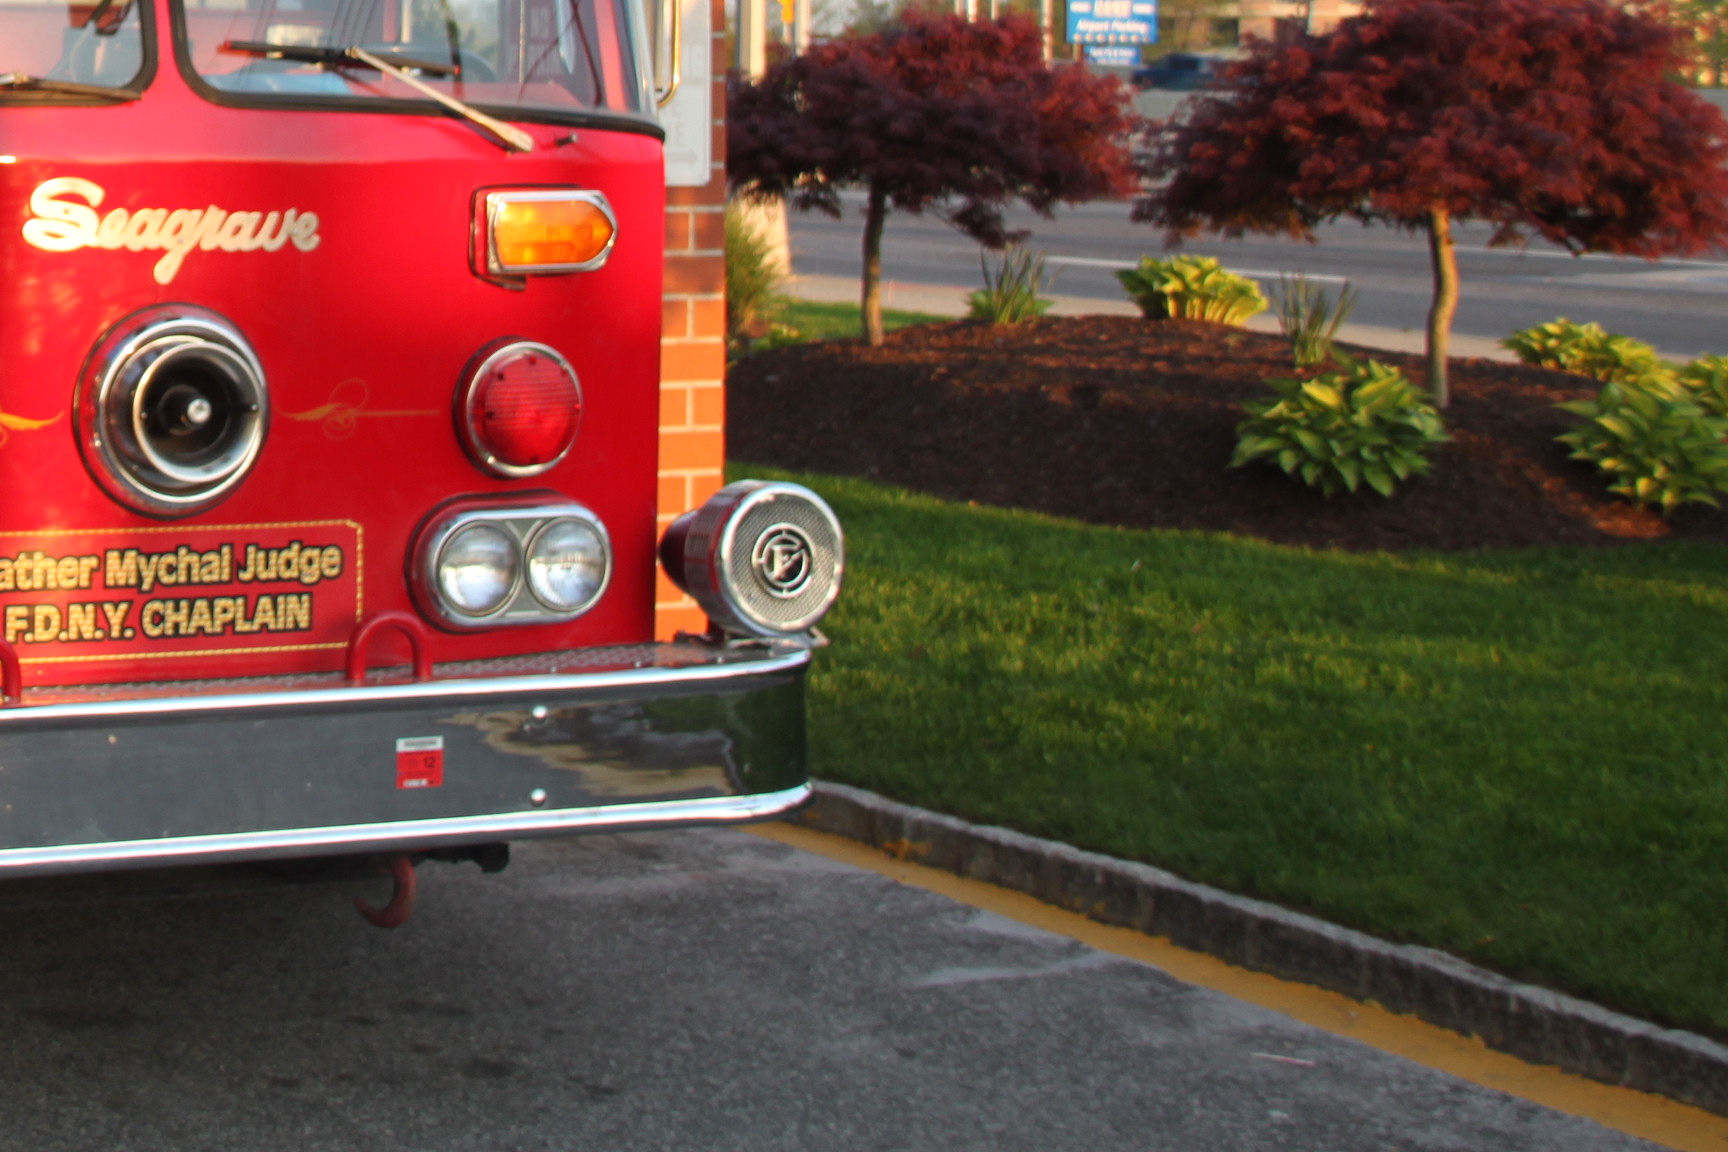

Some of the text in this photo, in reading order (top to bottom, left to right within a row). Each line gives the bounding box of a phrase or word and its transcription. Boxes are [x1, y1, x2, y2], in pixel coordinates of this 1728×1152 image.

[22, 176, 321, 285] Seagrave
[104, 543, 233, 593] Mychal
[237, 540, 344, 584] Judge
[4, 592, 312, 643] F.D.N.Y. CHAPLAIN
